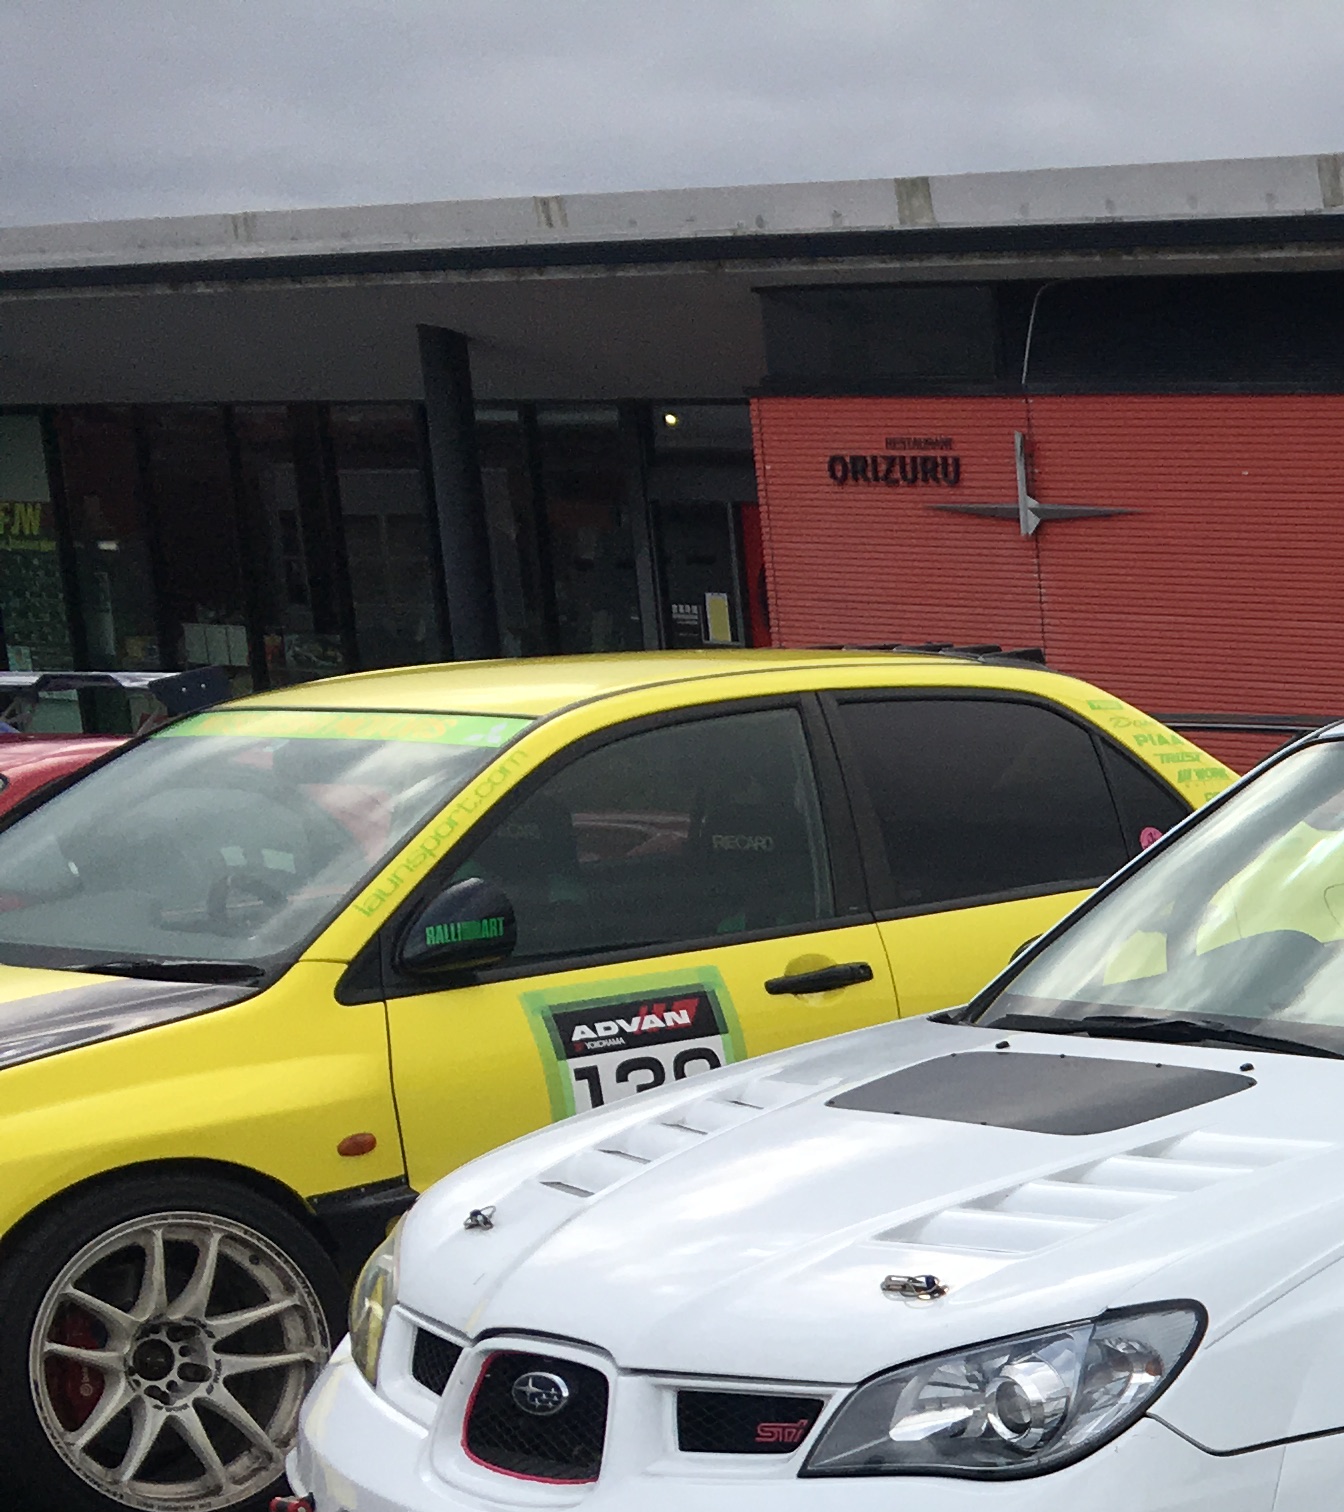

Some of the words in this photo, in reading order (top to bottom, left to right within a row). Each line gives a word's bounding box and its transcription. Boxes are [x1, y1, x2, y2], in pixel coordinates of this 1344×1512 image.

[827, 455, 960, 485] ORIZURU
[1133, 733, 1185, 747] PIAA
[711, 834, 774, 850] RECARO
[571, 1009, 691, 1042] ADVAN
